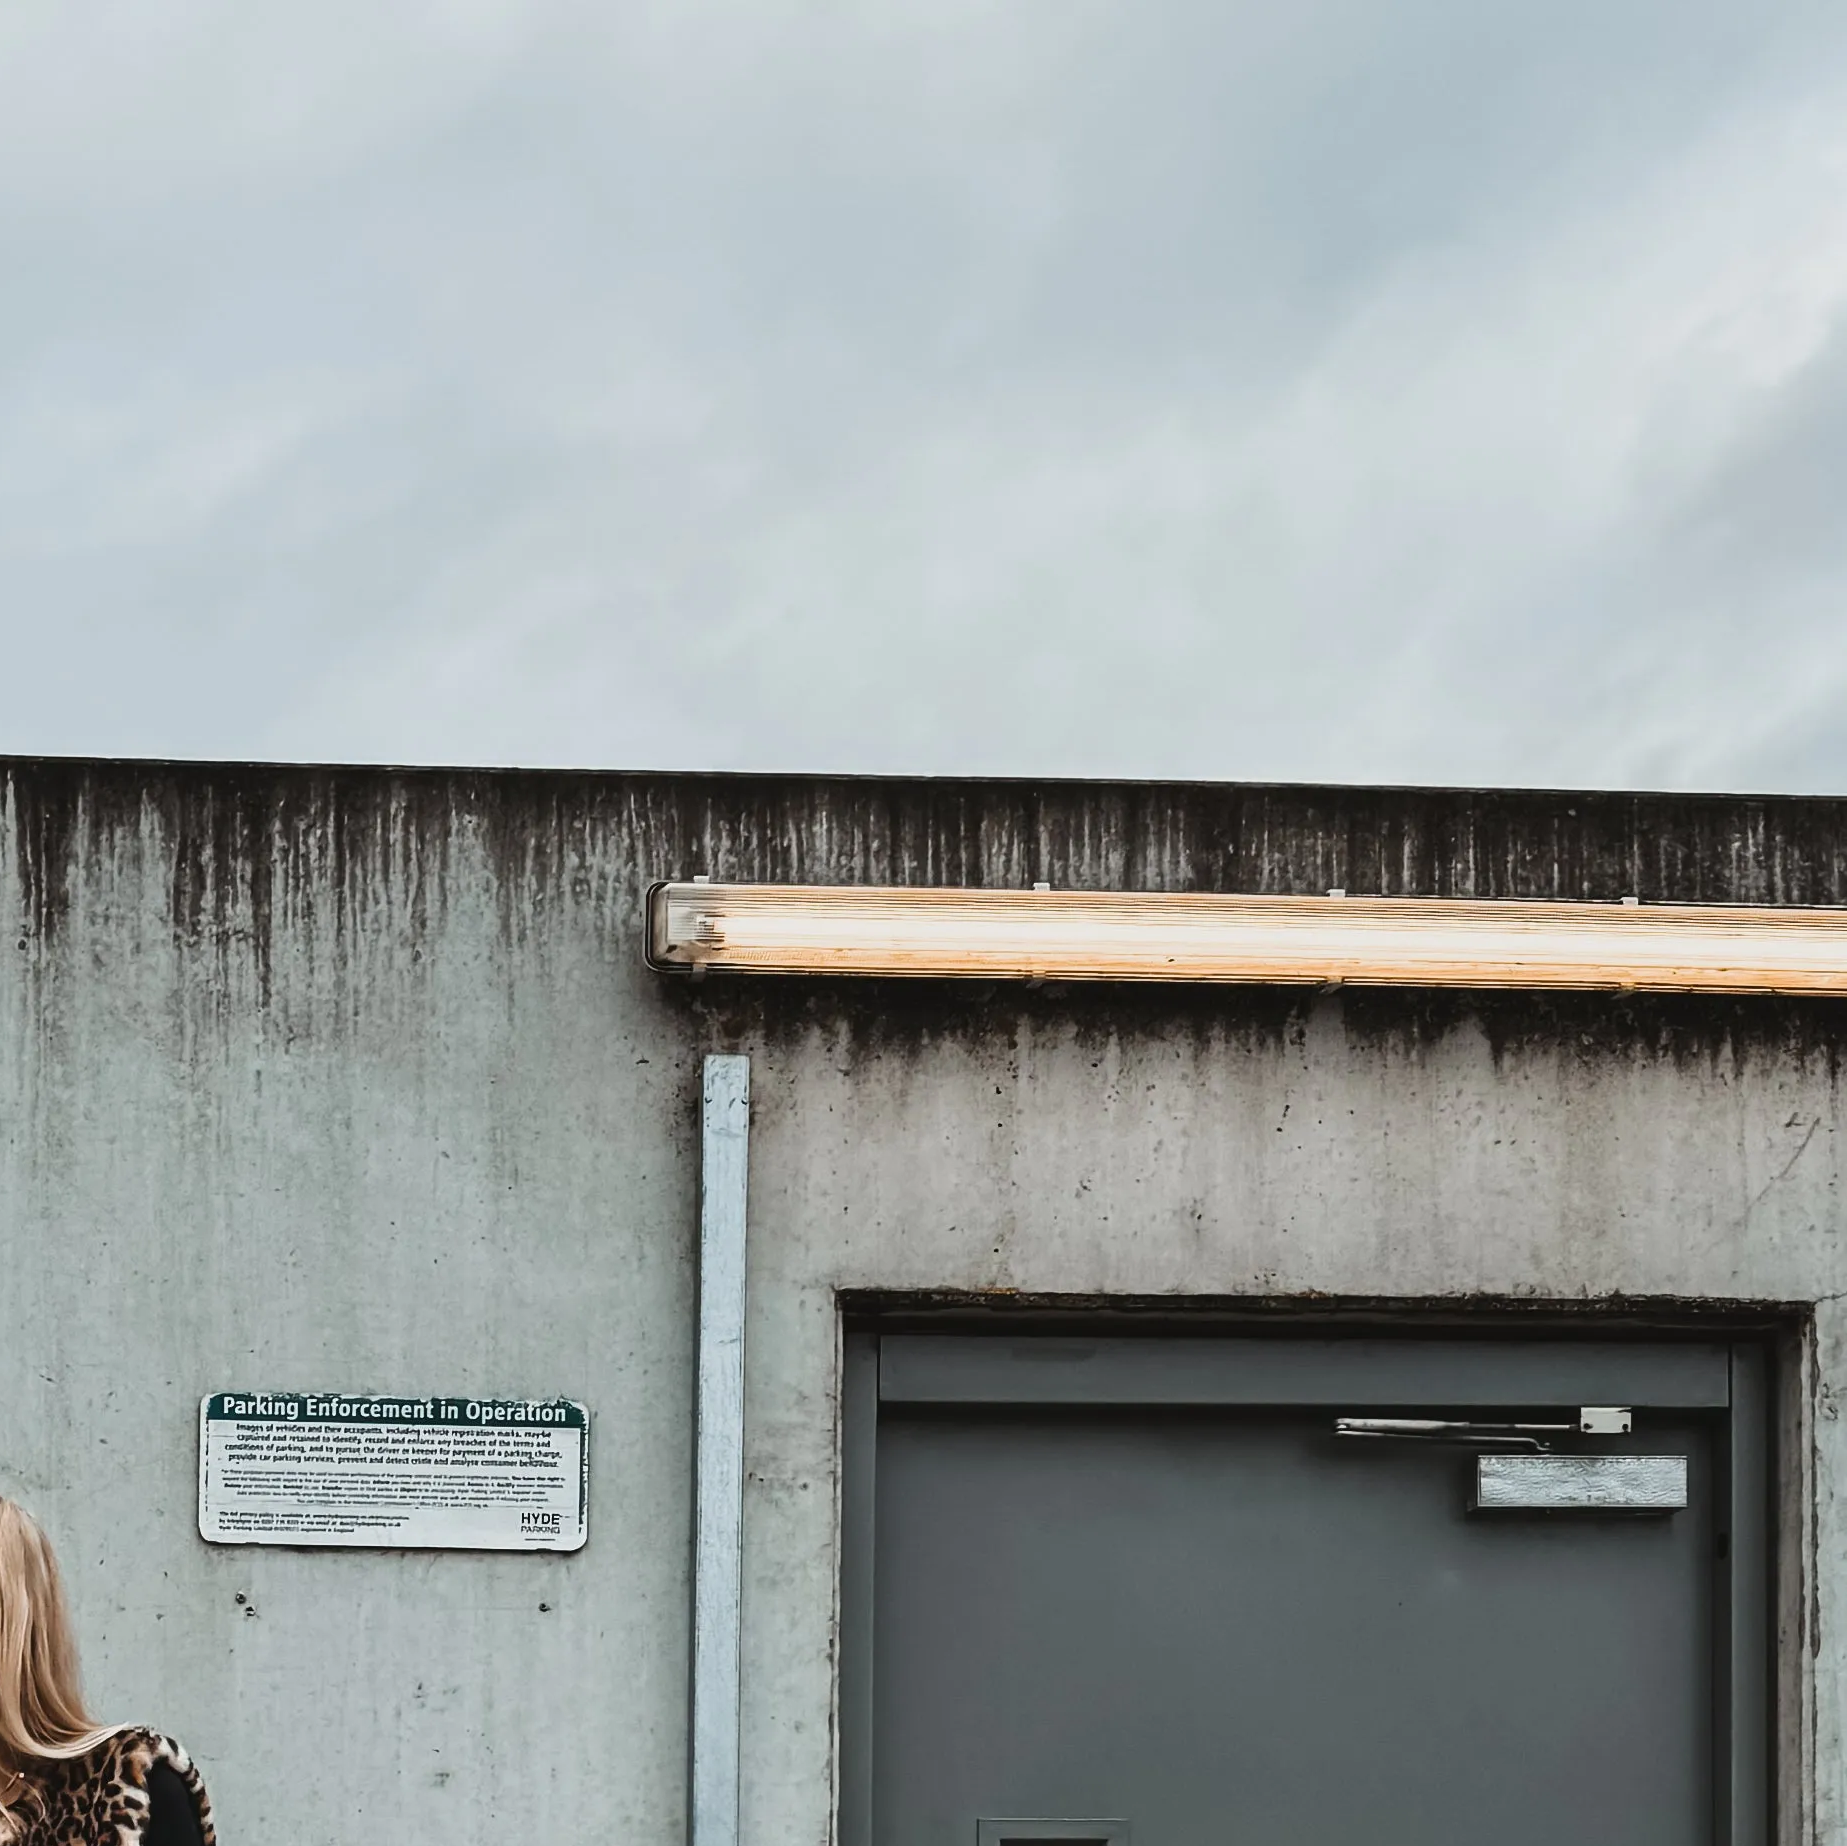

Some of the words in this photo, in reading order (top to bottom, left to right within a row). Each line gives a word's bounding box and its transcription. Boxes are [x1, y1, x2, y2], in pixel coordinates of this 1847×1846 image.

[223, 1396, 299, 1420] Parking
[306, 1398, 434, 1419] Enforcement
[440, 1400, 458, 1419] in
[466, 1402, 566, 1424] Operation
[387, 1427, 420, 1437] including
[536, 1440, 550, 1448] and
[378, 1446, 399, 1454] driver
[453, 1449, 485, 1457] payment
[229, 1453, 256, 1461] provide
[273, 1454, 301, 1463] parking
[521, 1512, 560, 1525] HYDE
[521, 1525, 560, 1534] PARKING
